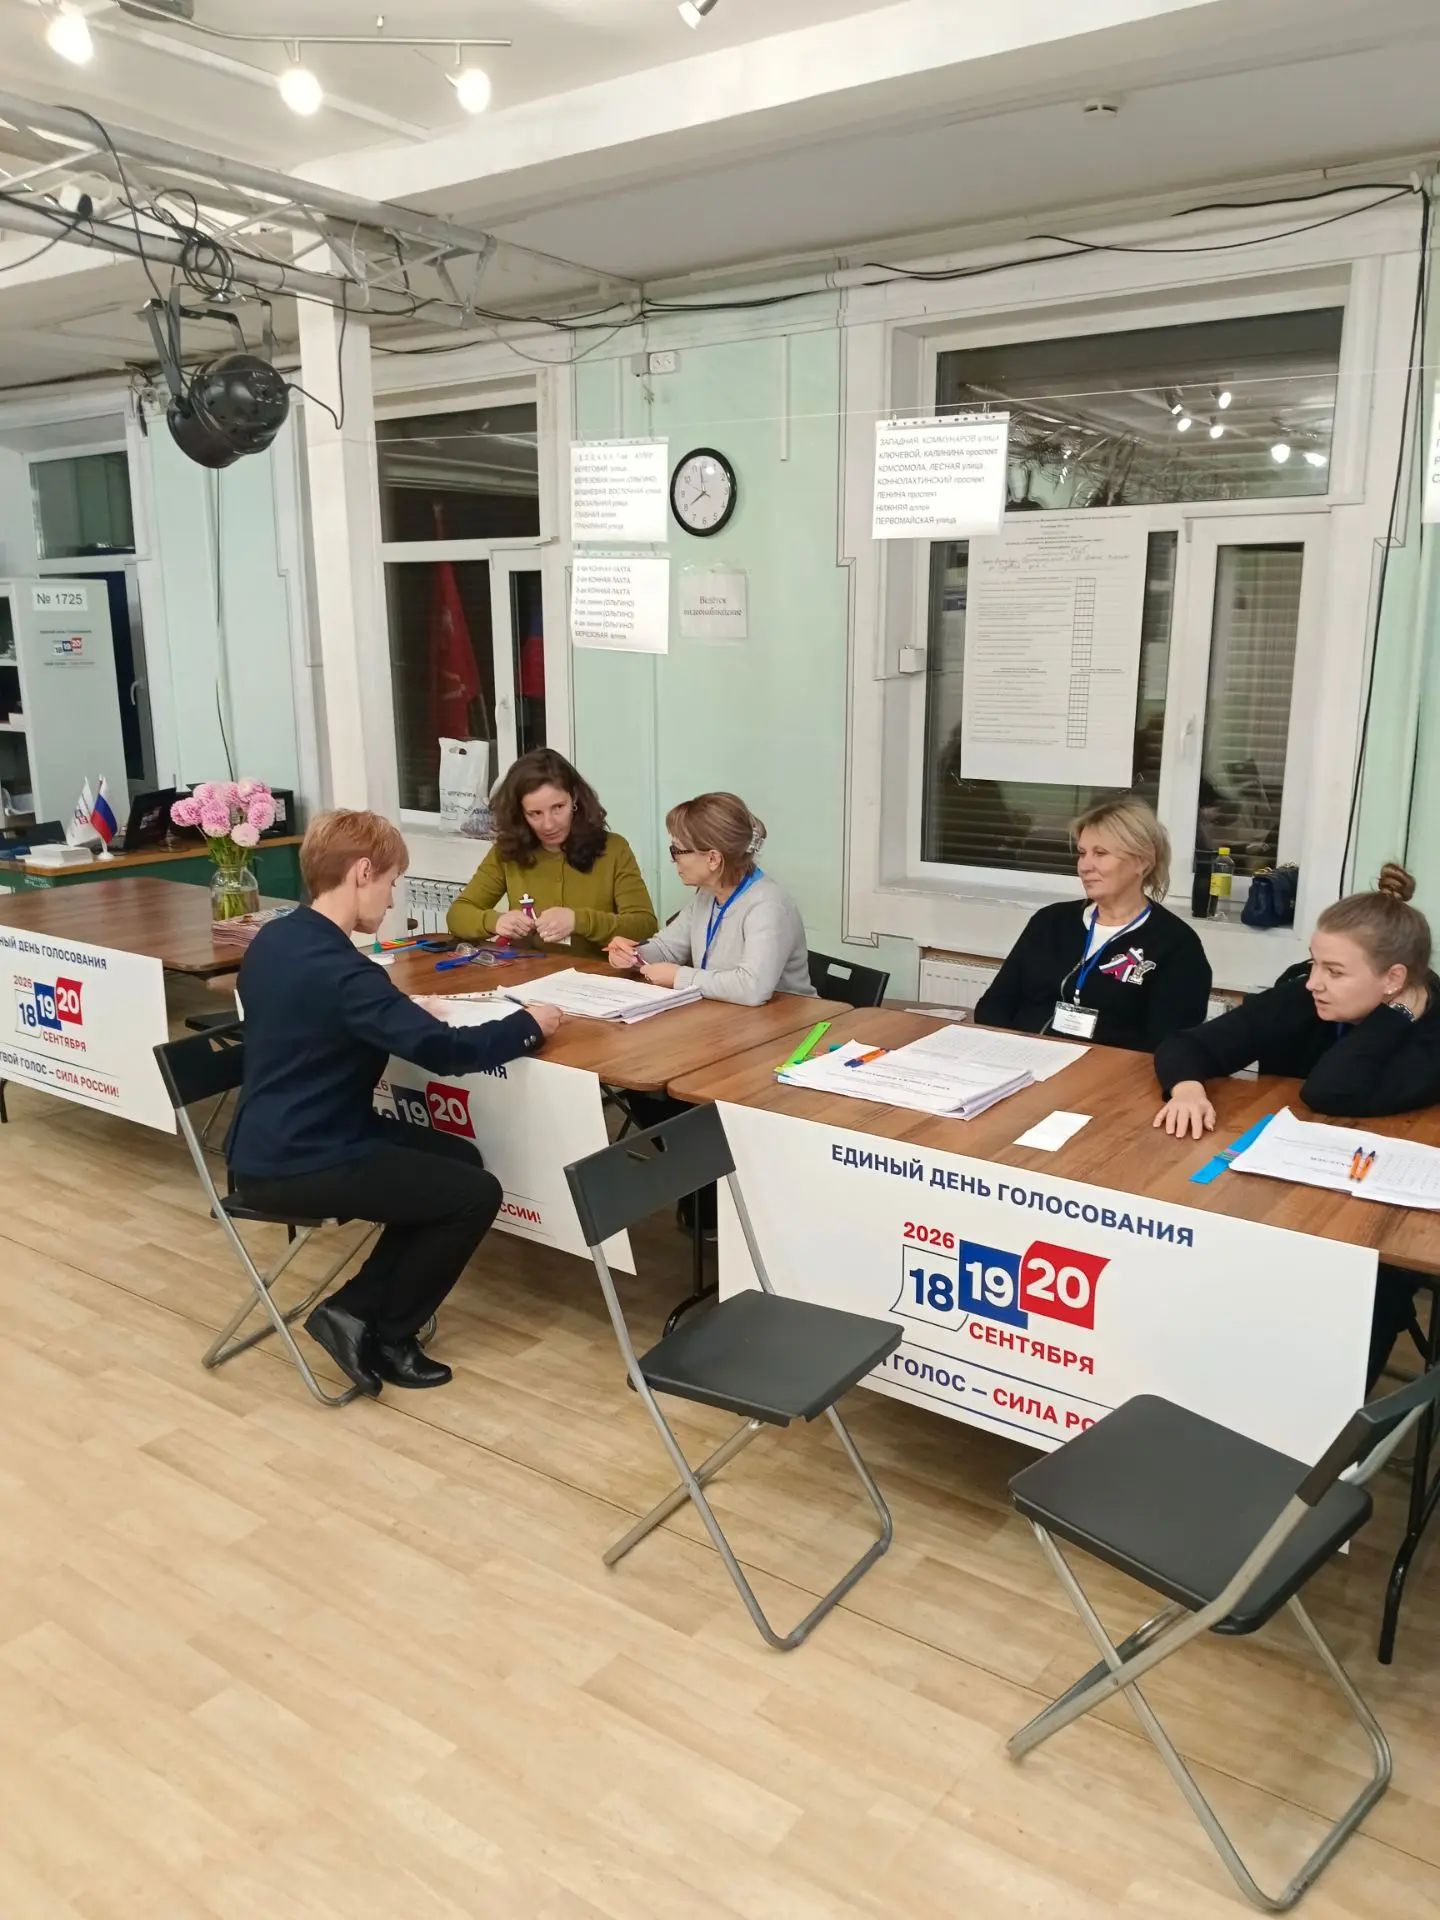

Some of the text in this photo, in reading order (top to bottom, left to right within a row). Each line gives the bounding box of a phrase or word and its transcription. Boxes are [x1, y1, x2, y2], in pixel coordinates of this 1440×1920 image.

[924, 449, 964, 457] КАЛИНИНА
[966, 448, 998, 457] проспект
[929, 462, 960, 471] ЛЕСНАЯ
[962, 463, 983, 471] улица
[877, 491, 906, 499] ЛЕНИНА
[875, 516, 934, 525] ПЕРВОМАЙСКАЯ
[37, 593, 83, 605] № 1725
[19, 940, 40, 954] ДЕНЬ
[41, 945, 107, 970] ГОЛОСОВАНИЯ
[14, 974, 33, 989] 2026
[19, 987, 80, 1027] 18 19 20
[43, 1031, 87, 1052] СЕНТЯБРЯ
[20, 1057, 47, 1074] ГОЛОС
[56, 1069, 79, 1086] СИЛА
[80, 1077, 120, 1098] РОССИИ!
[398, 1098, 430, 1128] 19
[430, 1093, 467, 1126] 20
[832, 1143, 1194, 1248] ЕДИНЫЙ ДЕНЬ ГОЛОСОВАНИЯ
[903, 1221, 955, 1249] 2026
[909, 1257, 1091, 1313] 18 19 20
[969, 1321, 1094, 1375] СЕНТЯБРЯ
[893, 1353, 966, 1392] ГОЛОС
[993, 1387, 1058, 1424] СИЛА
